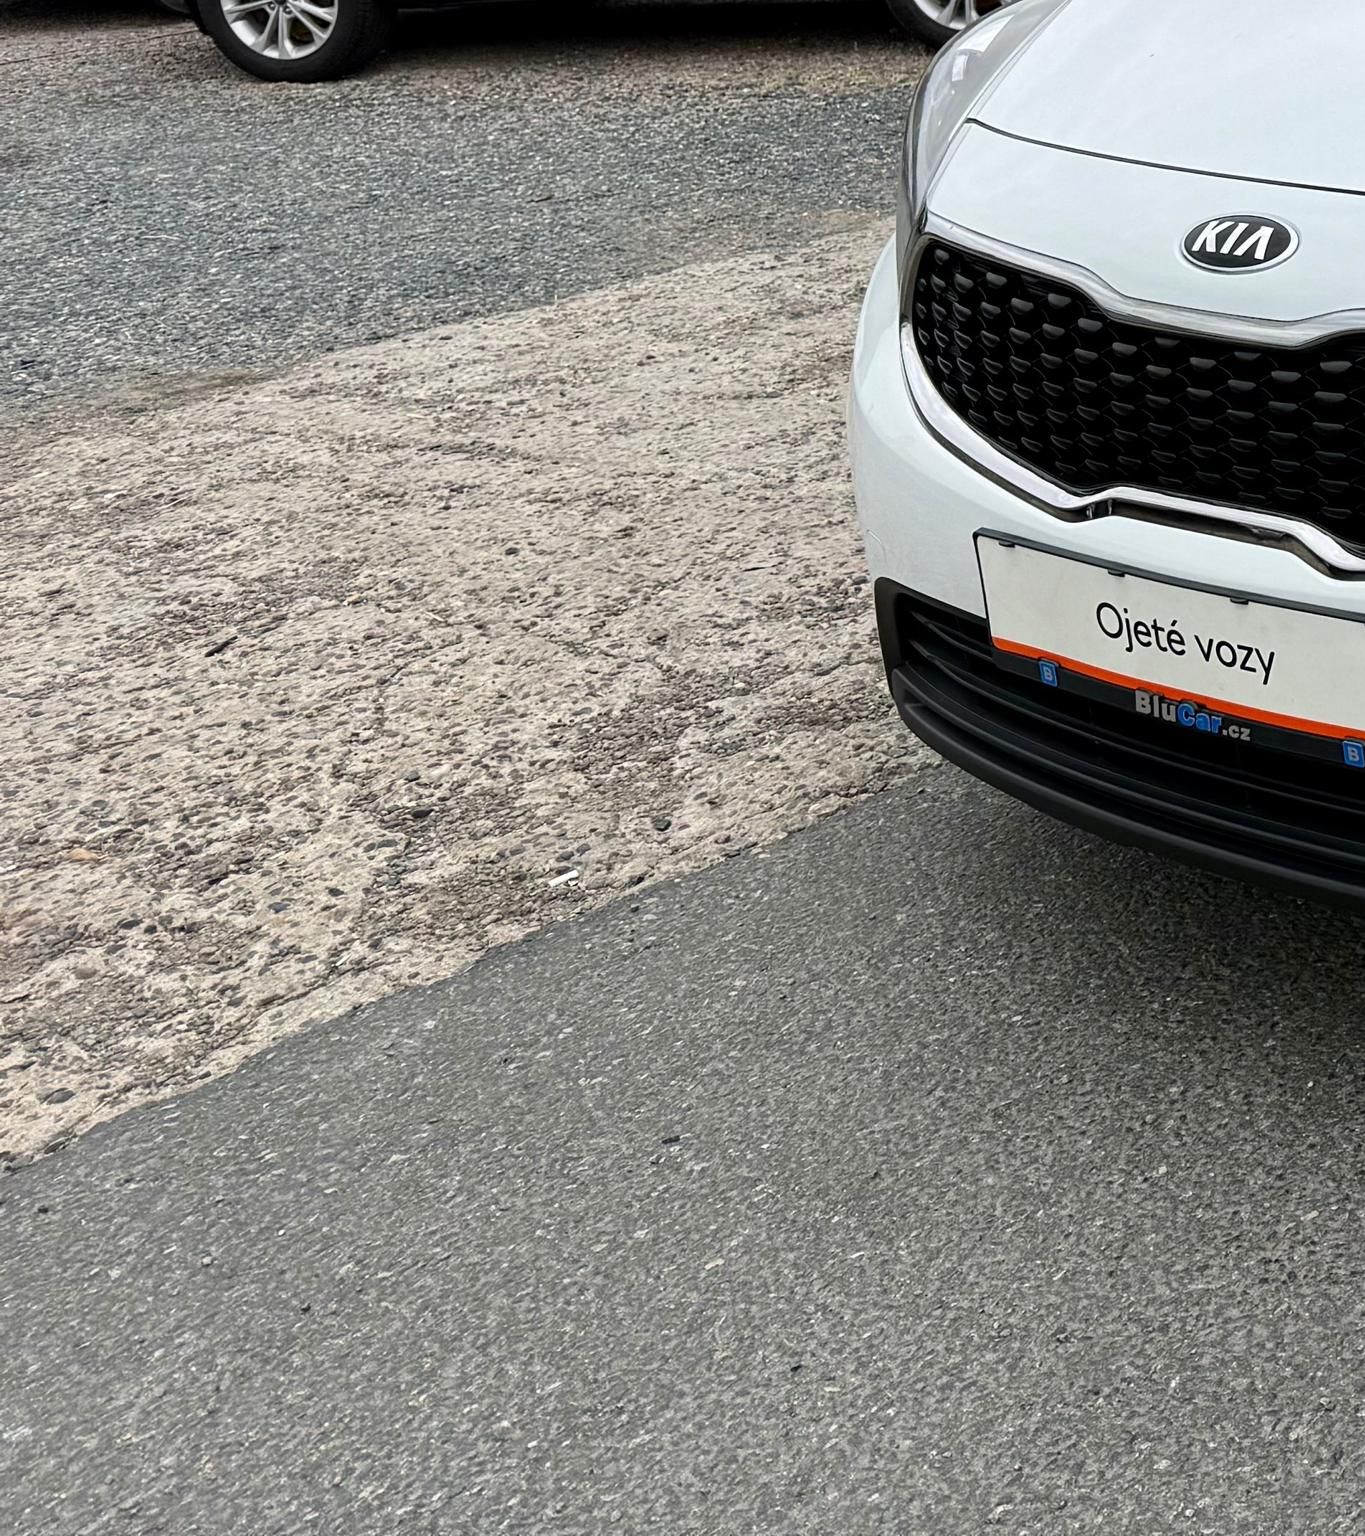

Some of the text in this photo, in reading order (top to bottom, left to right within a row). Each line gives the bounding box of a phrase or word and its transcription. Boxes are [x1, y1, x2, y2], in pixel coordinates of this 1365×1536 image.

[1191, 220, 1275, 260] KIA
[1096, 602, 1275, 685] Ojeté vozy
[1135, 689, 1251, 741] BluCar.cz
